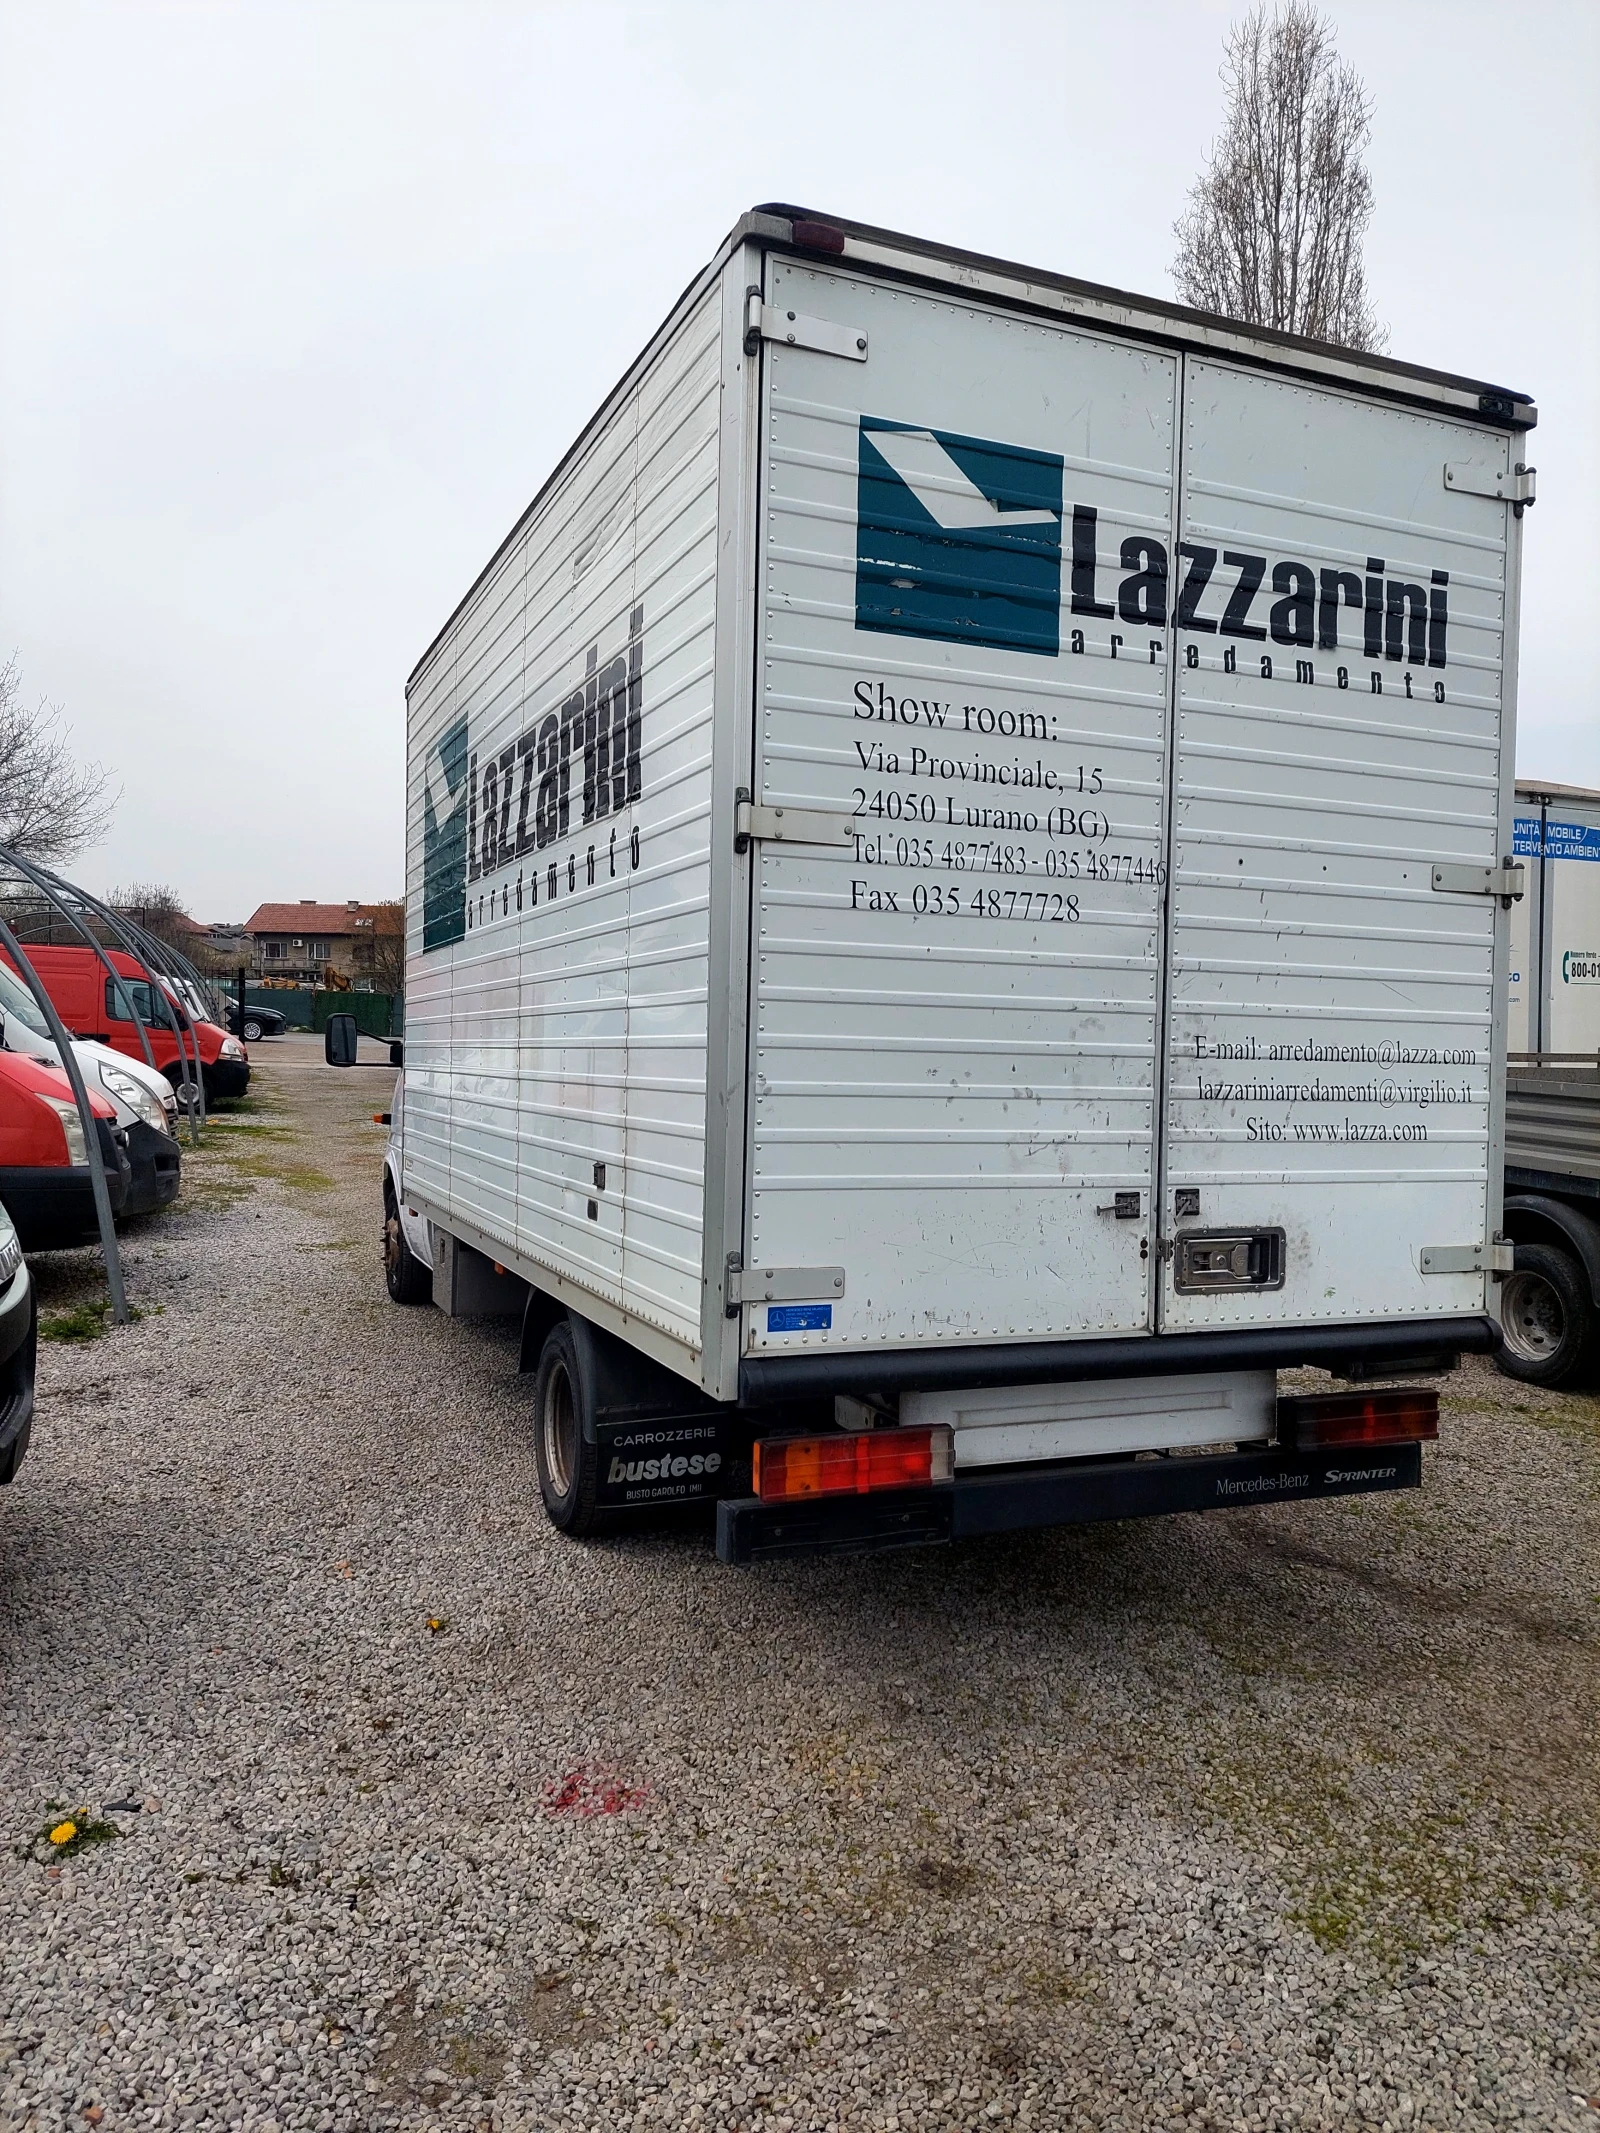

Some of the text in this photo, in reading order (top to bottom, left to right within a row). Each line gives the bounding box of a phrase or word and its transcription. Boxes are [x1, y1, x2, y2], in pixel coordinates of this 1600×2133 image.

[1071, 504, 1449, 669] Lazzarini
[1072, 629, 1446, 703] arredamento
[853, 680, 1058, 741] Show room:
[468, 603, 644, 883] Lazzarini
[853, 741, 1103, 796] Via Provinciale, 15
[852, 788, 1109, 846] 24050 Lurano (BG)
[1548, 826, 1581, 840] MOBILE
[852, 833, 888, 865] Tel.
[897, 837, 933, 868] 035
[941, 841, 1026, 875] 4877483
[1045, 849, 1080, 878] 035
[1087, 852, 1166, 885] 4877446
[1513, 840, 1563, 856] TERVENTO
[468, 826, 640, 929] arredamento
[849, 880, 1080, 923] Fax 035 4877728
[1194, 1035, 1476, 1070] E-mail: arredamento@lazza.com
[1197, 1075, 1473, 1108] lazzariniarredamenti@virgilio.it
[1246, 1116, 1428, 1141] Sito: www.lazza.com
[613, 1427, 716, 1447] CARROZZERIE
[607, 1453, 721, 1483] bustese
[1216, 1467, 1397, 1495] Mercedes-Benz SPRINTER
[626, 1489, 650, 1500] BUSTO
[651, 1485, 686, 1497] GAROLFO
